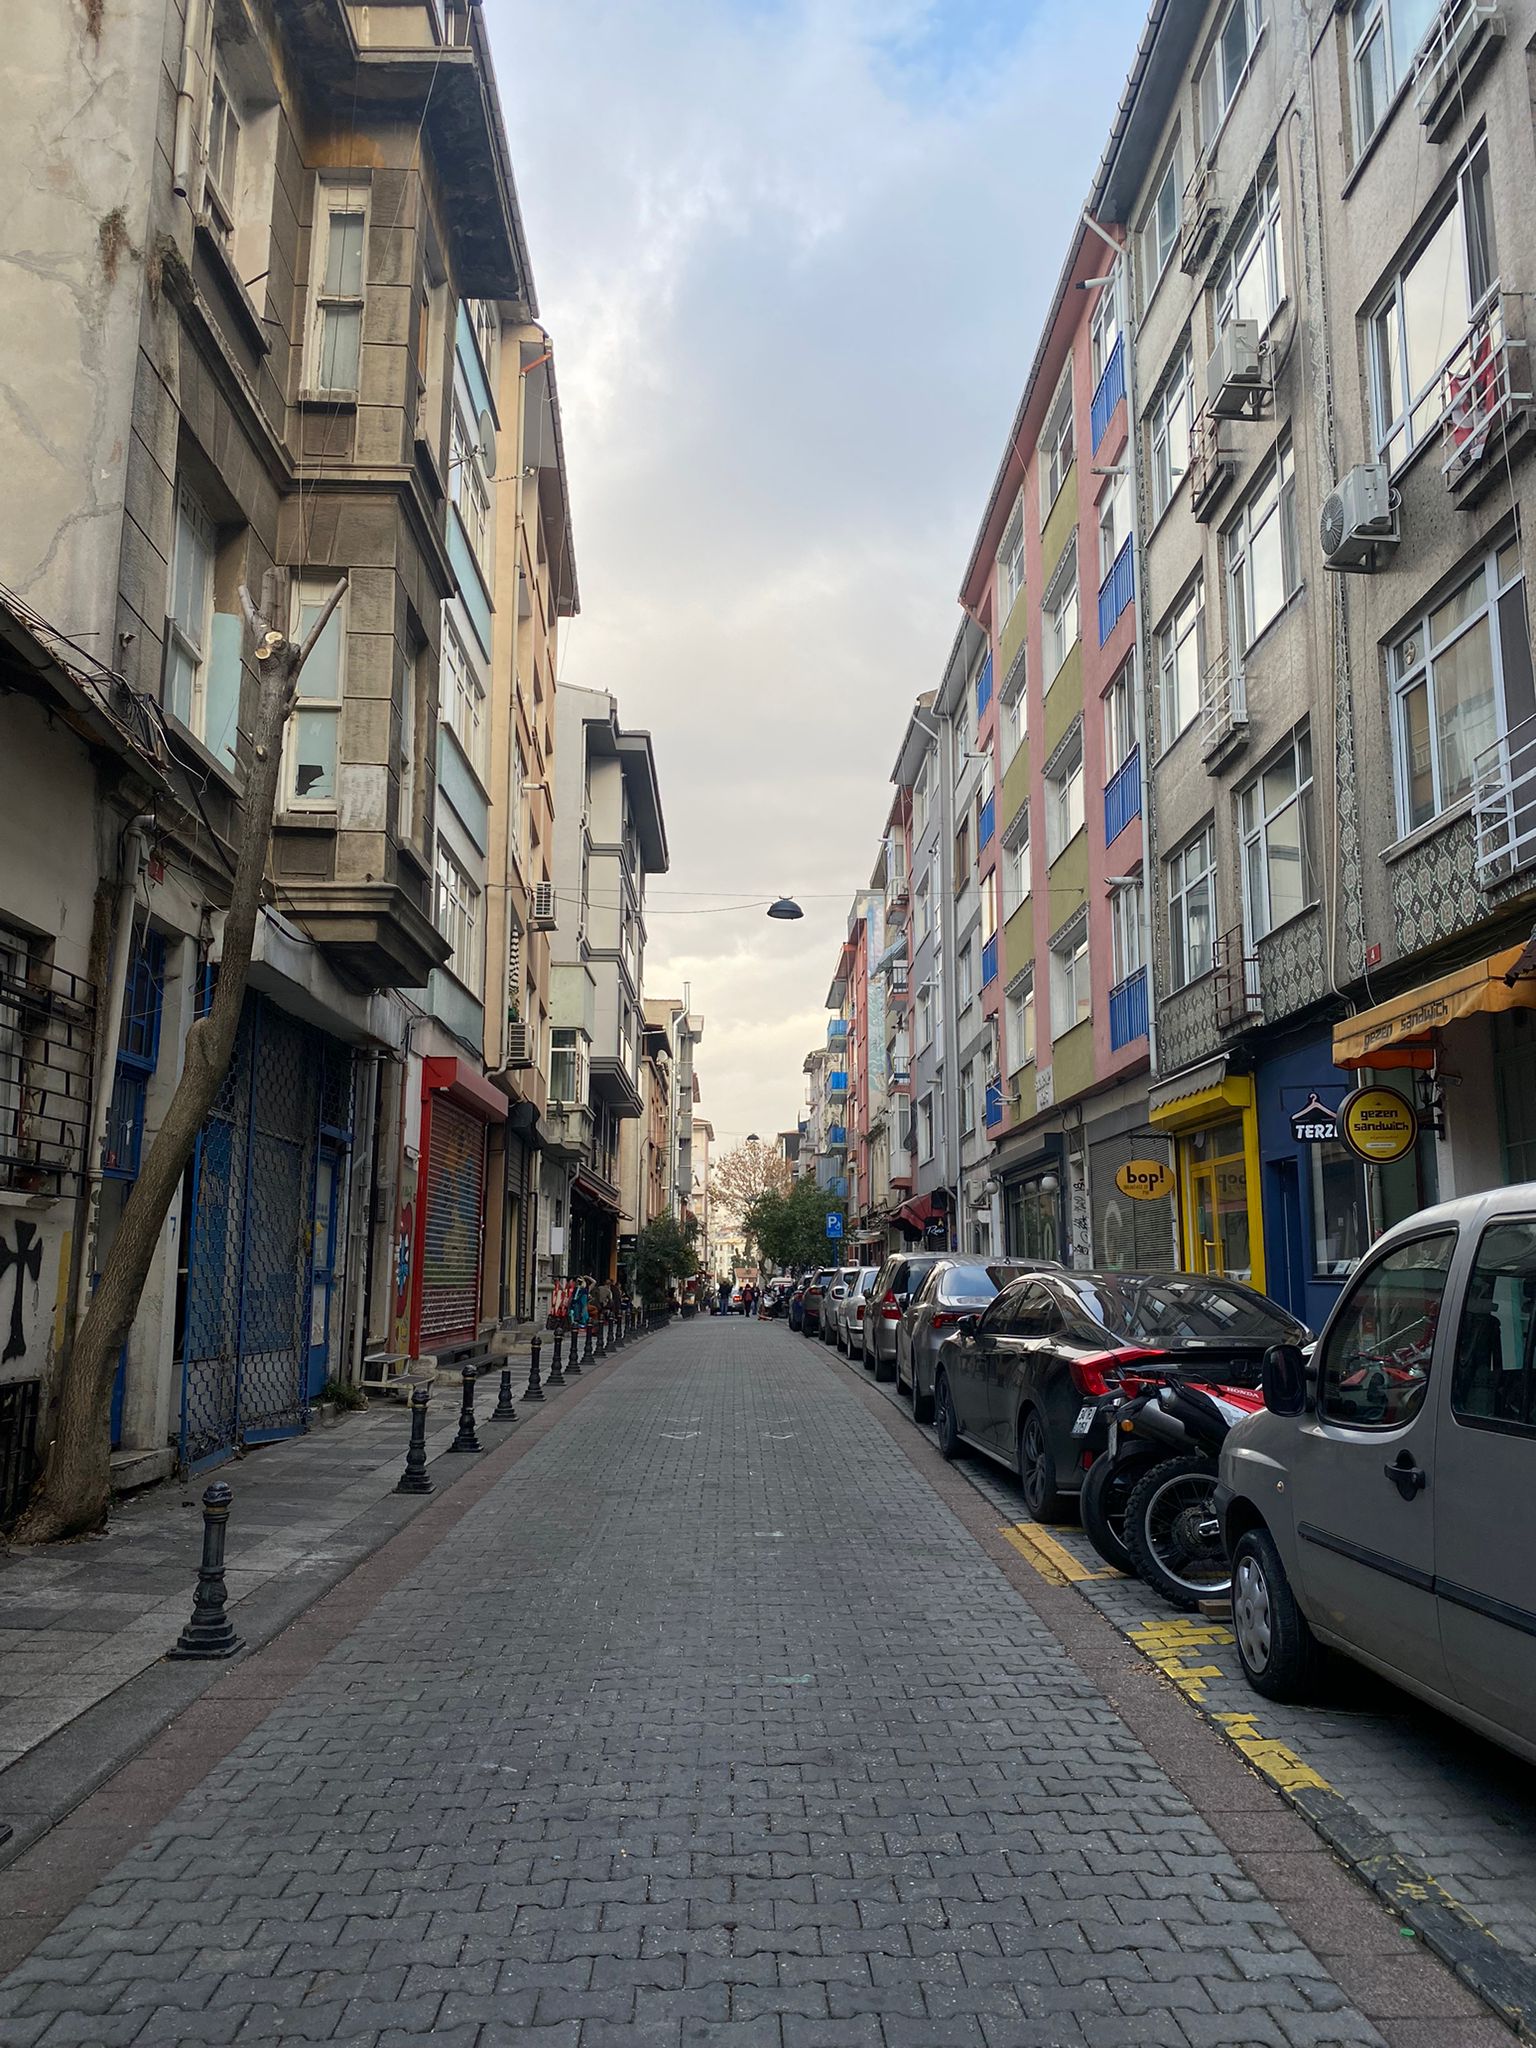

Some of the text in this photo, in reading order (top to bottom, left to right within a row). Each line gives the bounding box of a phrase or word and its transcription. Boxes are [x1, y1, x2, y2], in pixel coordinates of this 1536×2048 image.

[1363, 1000, 1448, 1050] gezen sandwich
[1360, 1109, 1398, 1121] gezen
[1353, 1121, 1409, 1132] sandwich
[1126, 1165, 1164, 1191] bop!
[828, 1216, 838, 1228] P
[1226, 1386, 1259, 1399] HONDA
